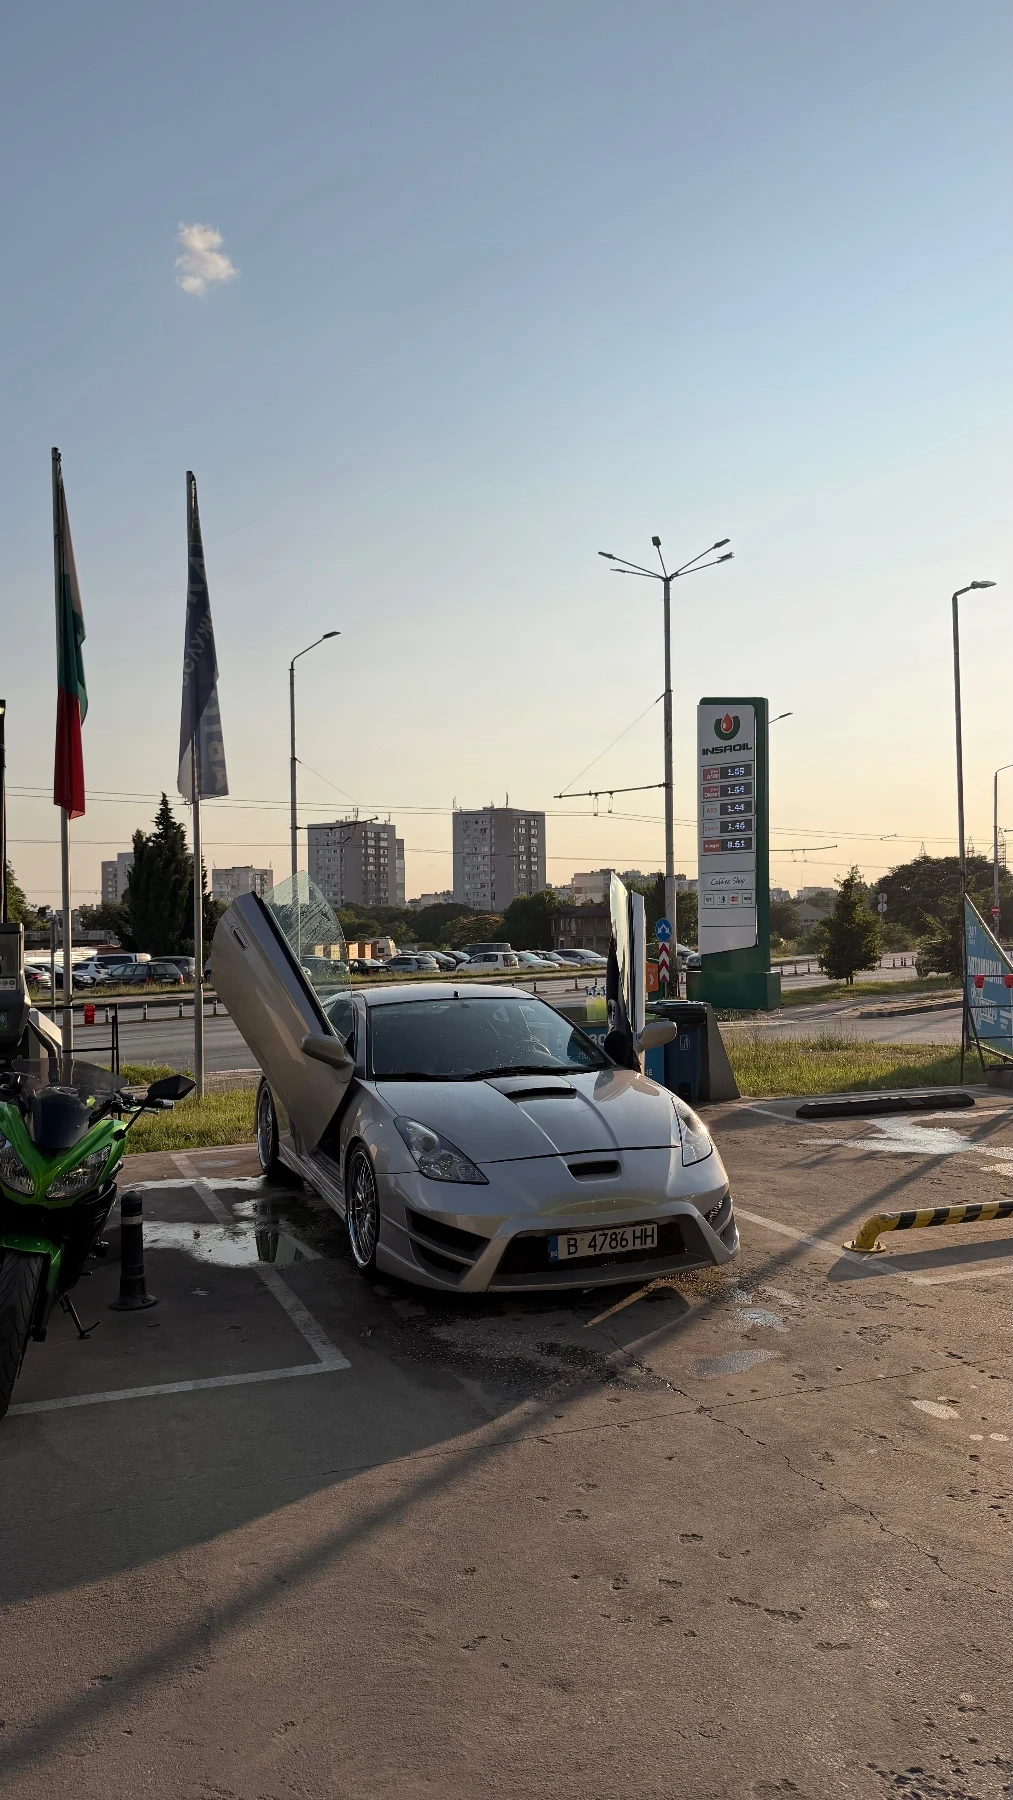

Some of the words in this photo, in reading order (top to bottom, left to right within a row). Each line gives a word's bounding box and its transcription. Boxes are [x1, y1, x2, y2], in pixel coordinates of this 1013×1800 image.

[702, 742, 752, 756] INSAOIL
[710, 877, 731, 886] Coffee
[732, 876, 746, 887] Shop
[566, 1237, 579, 1256] B
[587, 1230, 629, 1253] 4786
[632, 1226, 656, 1247] HH
